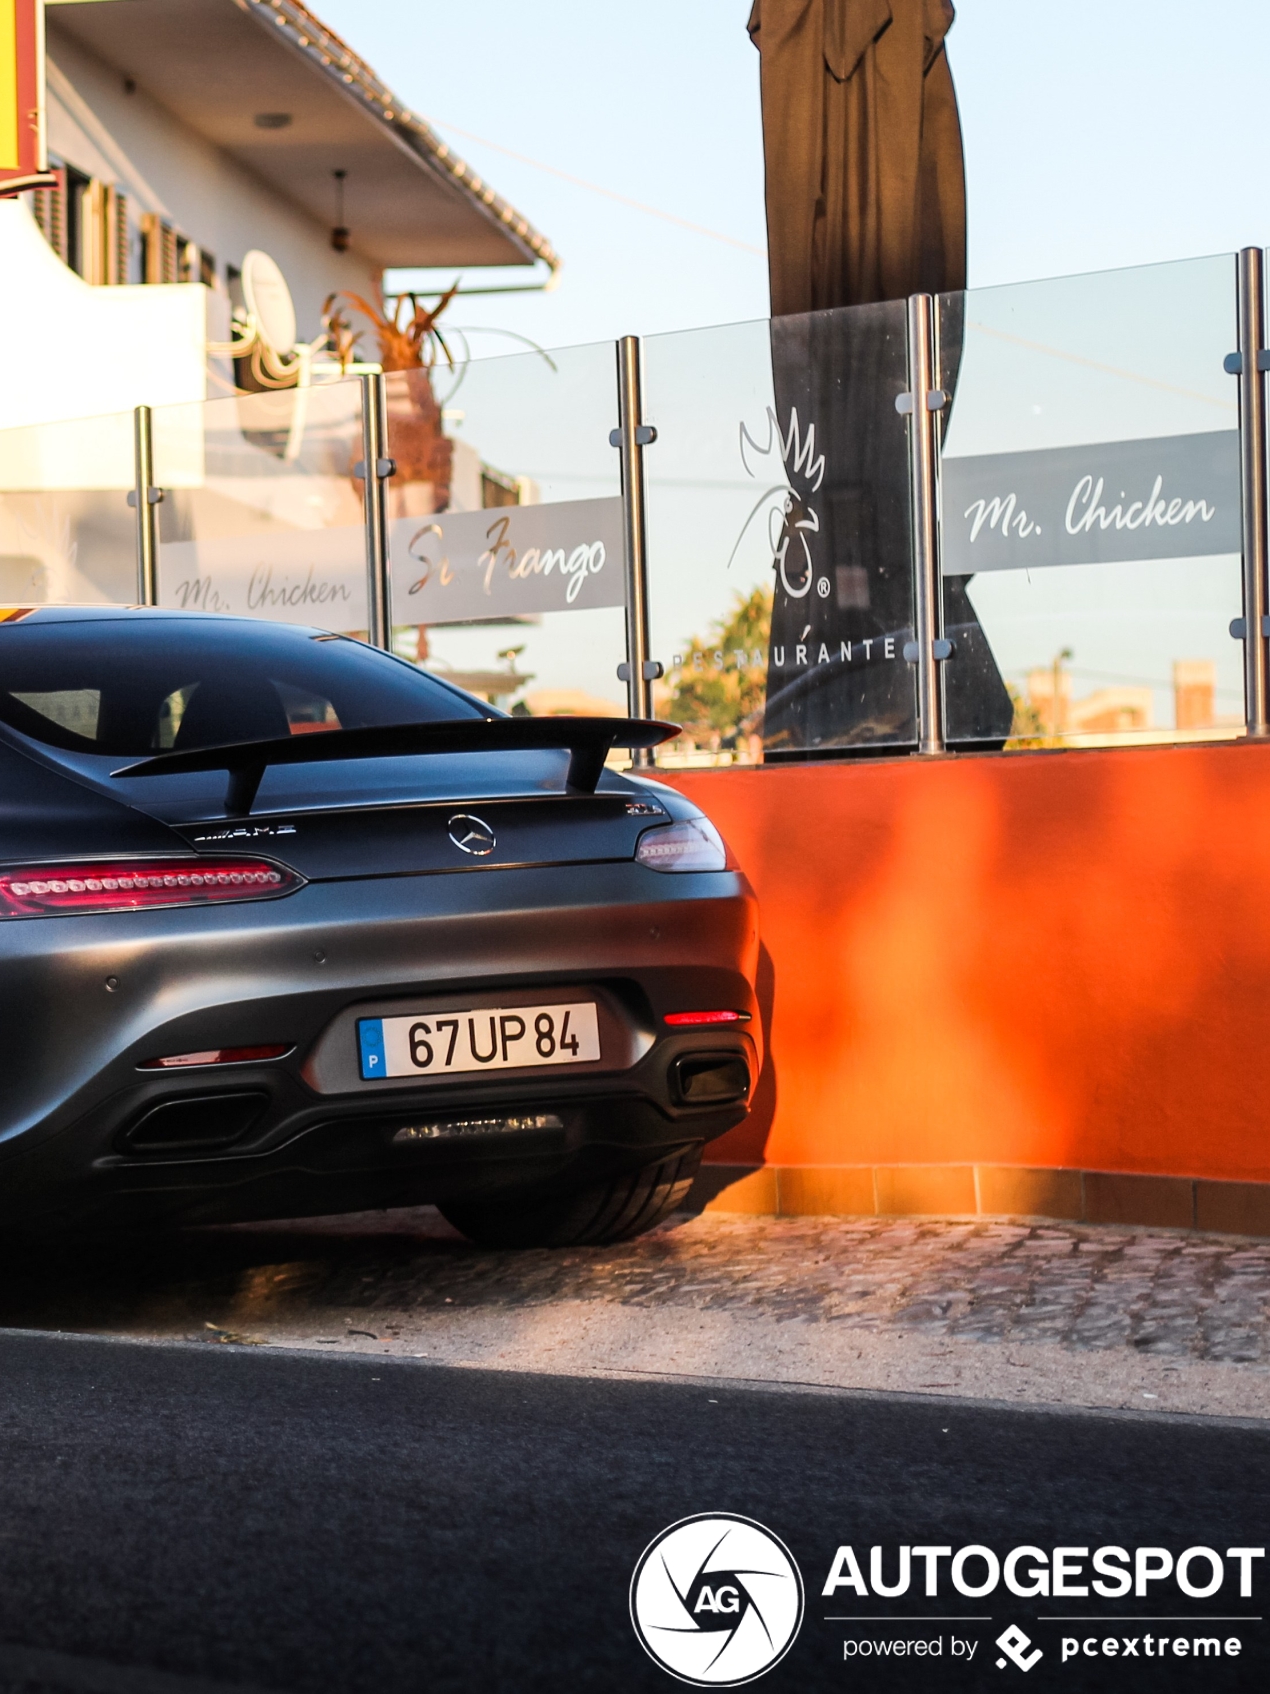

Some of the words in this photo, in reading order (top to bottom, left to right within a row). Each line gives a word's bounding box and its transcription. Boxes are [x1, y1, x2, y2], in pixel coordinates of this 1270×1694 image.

[964, 493, 1042, 543] Mr.
[1065, 474, 1216, 535] Chicken
[478, 516, 606, 603] Frango
[175, 575, 230, 612] Mr.
[246, 560, 352, 610] Chicken
[672, 637, 896, 672] RESTAURANTE
[368, 1055, 378, 1068] P
